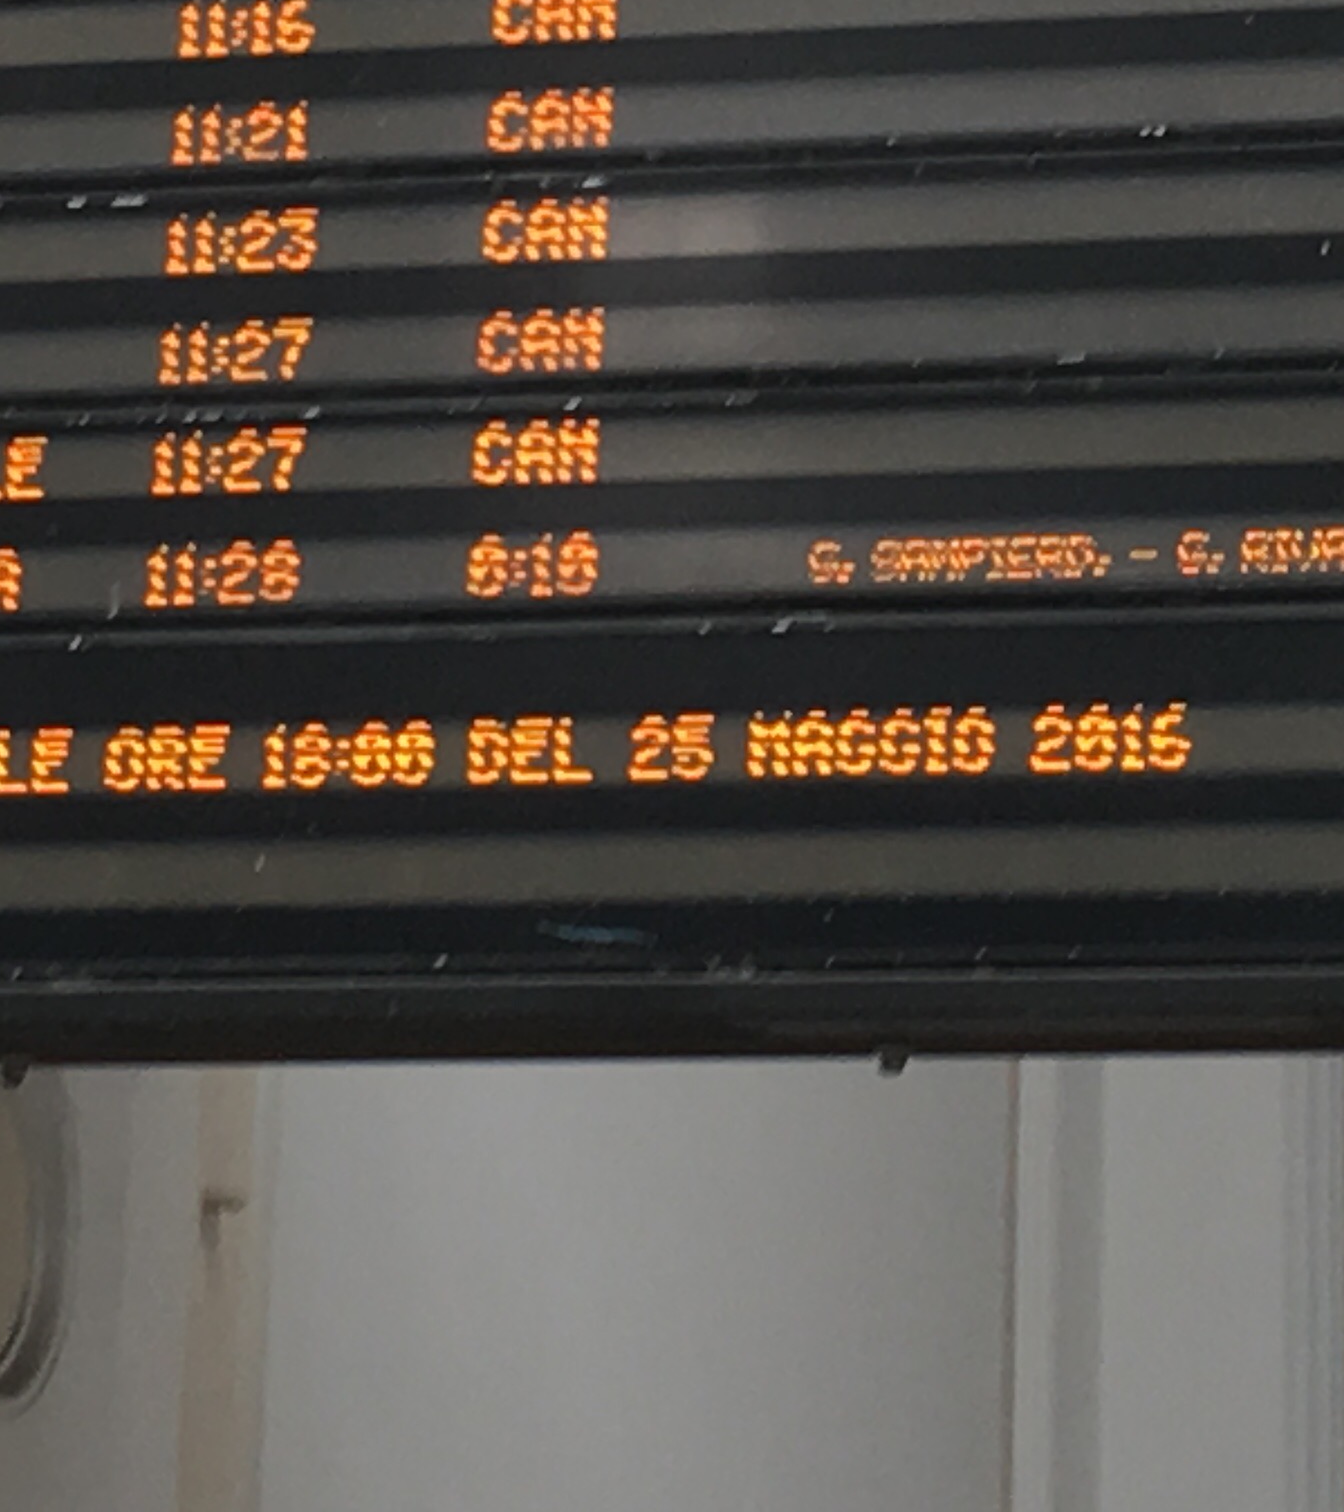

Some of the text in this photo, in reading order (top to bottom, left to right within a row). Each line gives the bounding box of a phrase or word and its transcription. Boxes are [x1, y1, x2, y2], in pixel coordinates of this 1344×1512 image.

[170, 100, 309, 166] 11:21
[485, 86, 615, 153] CAN
[163, 207, 319, 276] 11:23
[480, 196, 612, 264] CAN
[157, 317, 314, 385] 11:27
[475, 306, 606, 375] CAN
[150, 426, 307, 496] 11:27
[470, 418, 601, 486] CAN
[143, 539, 302, 608] 11:28
[102, 723, 231, 793] ORE
[465, 716, 594, 786] DEL
[626, 713, 715, 782] 25
[745, 706, 997, 778] MAGGIO
[1027, 702, 1193, 774] 2016
